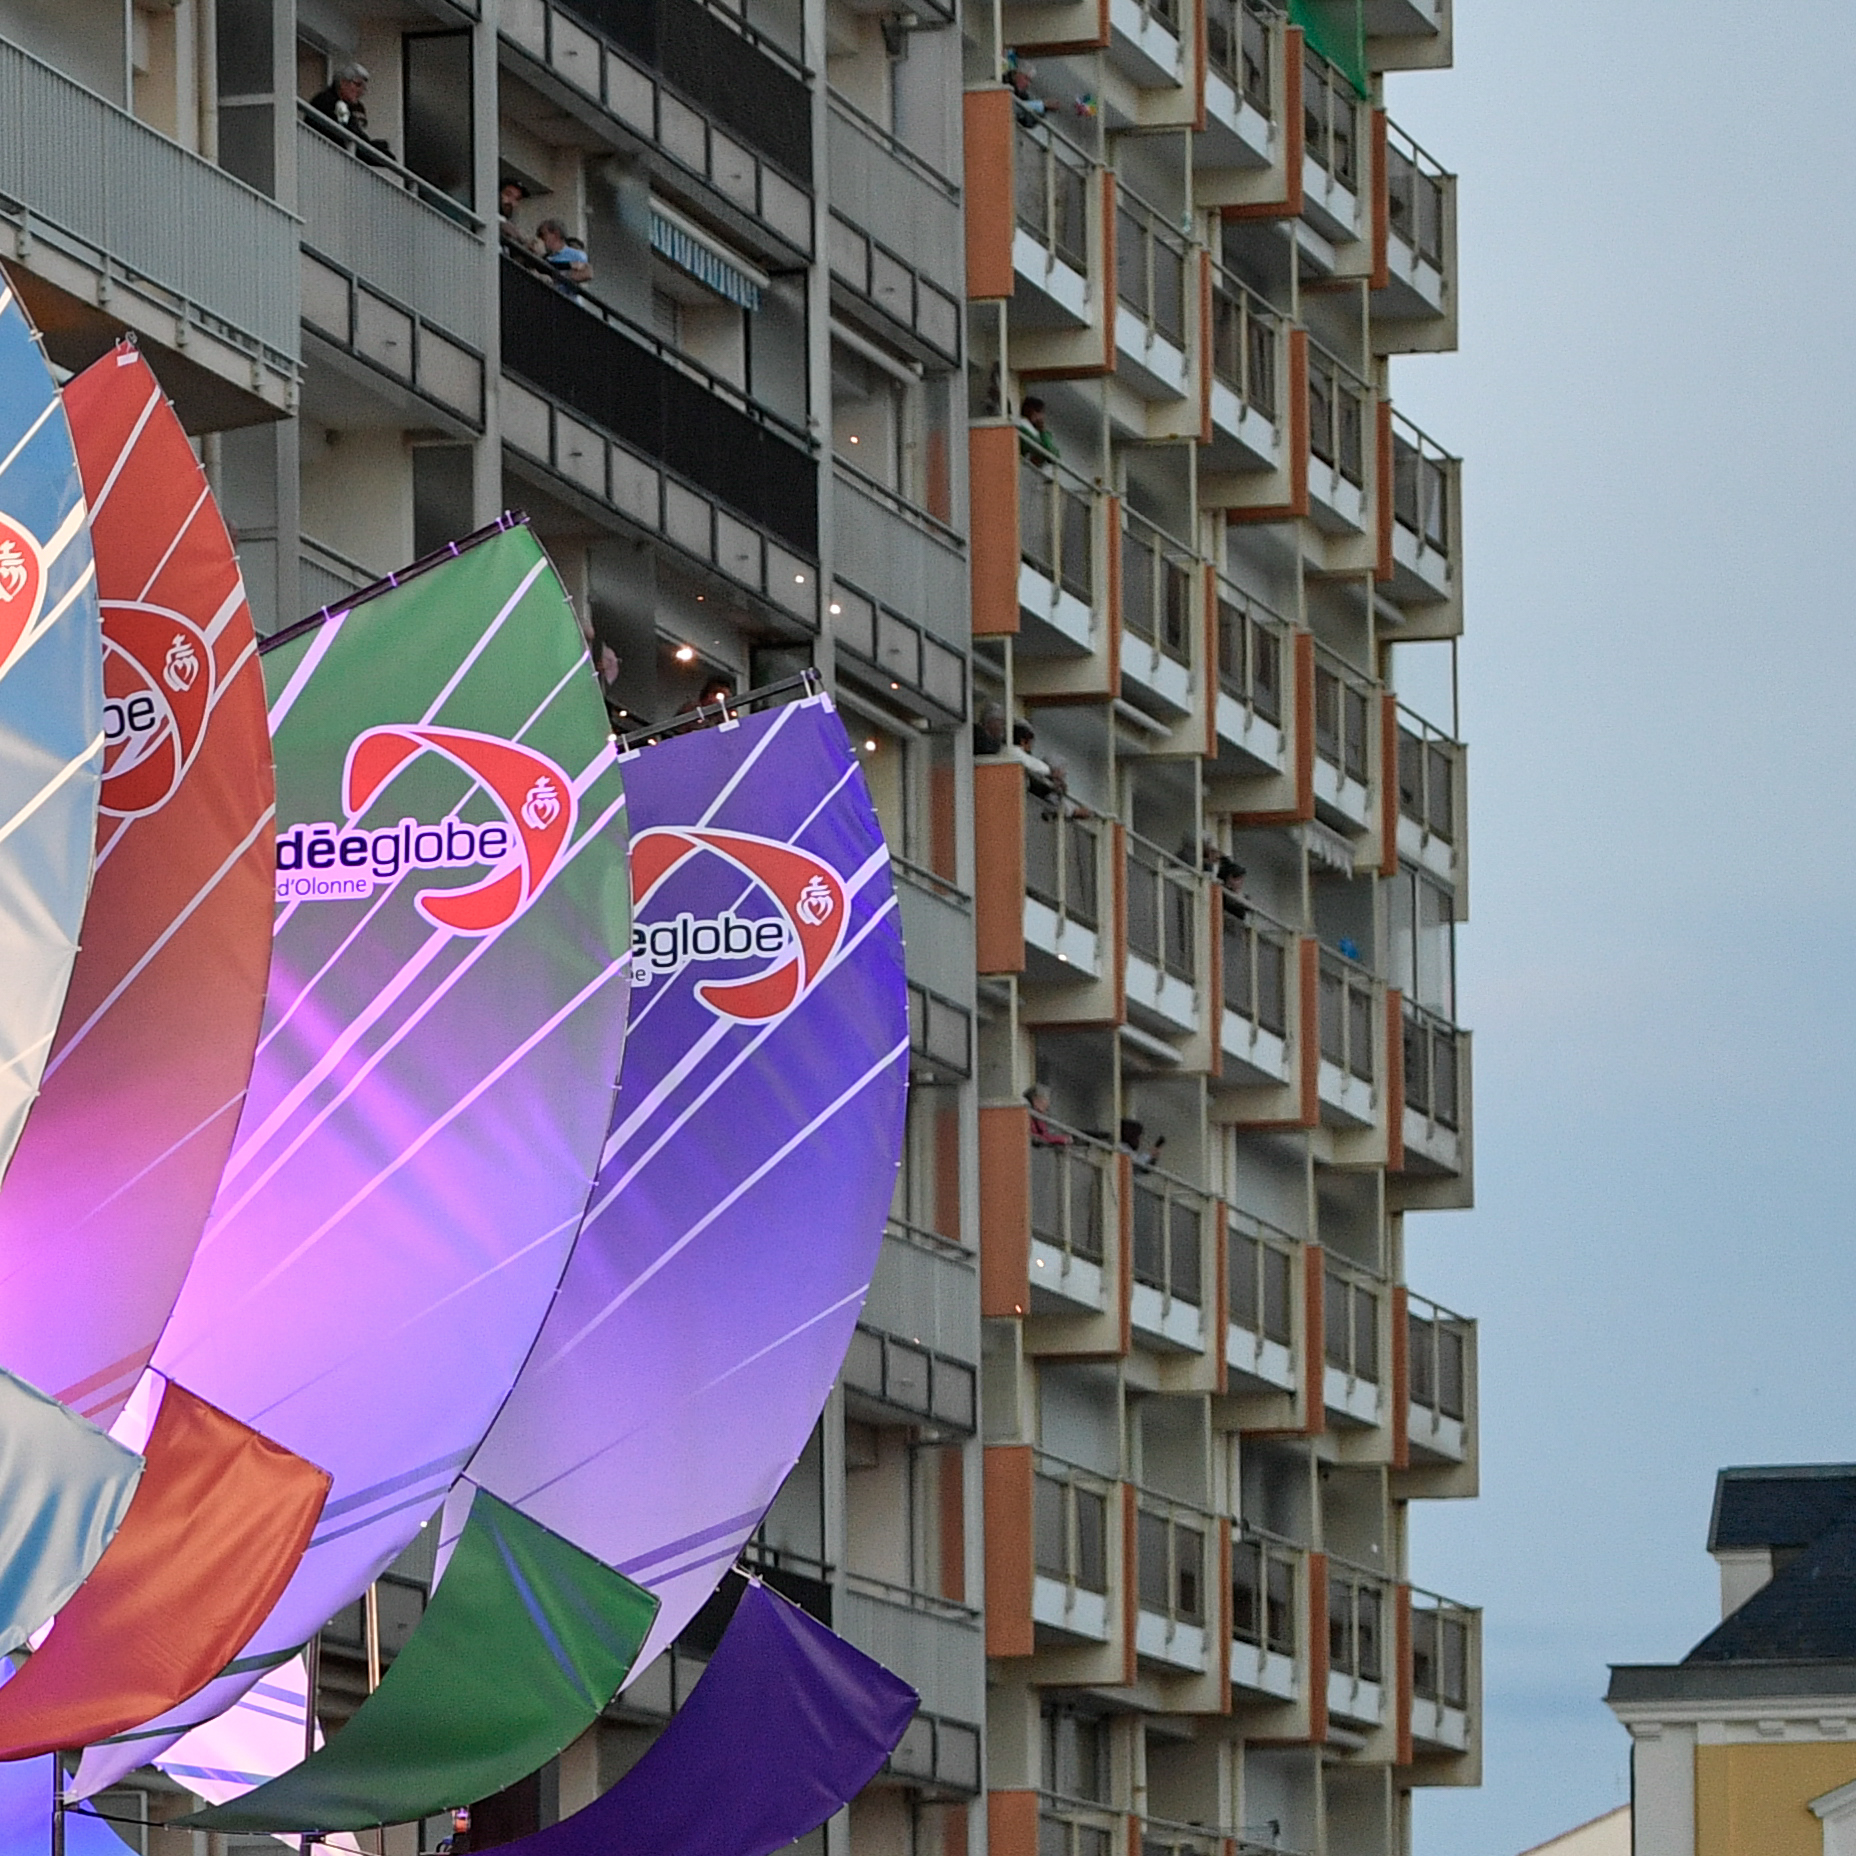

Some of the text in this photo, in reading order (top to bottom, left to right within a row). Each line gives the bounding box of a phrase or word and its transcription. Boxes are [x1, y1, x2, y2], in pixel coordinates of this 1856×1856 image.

[276, 822, 508, 877] déeglobe
[278, 877, 367, 897] d'Olonne
[632, 917, 784, 968] eglobe
